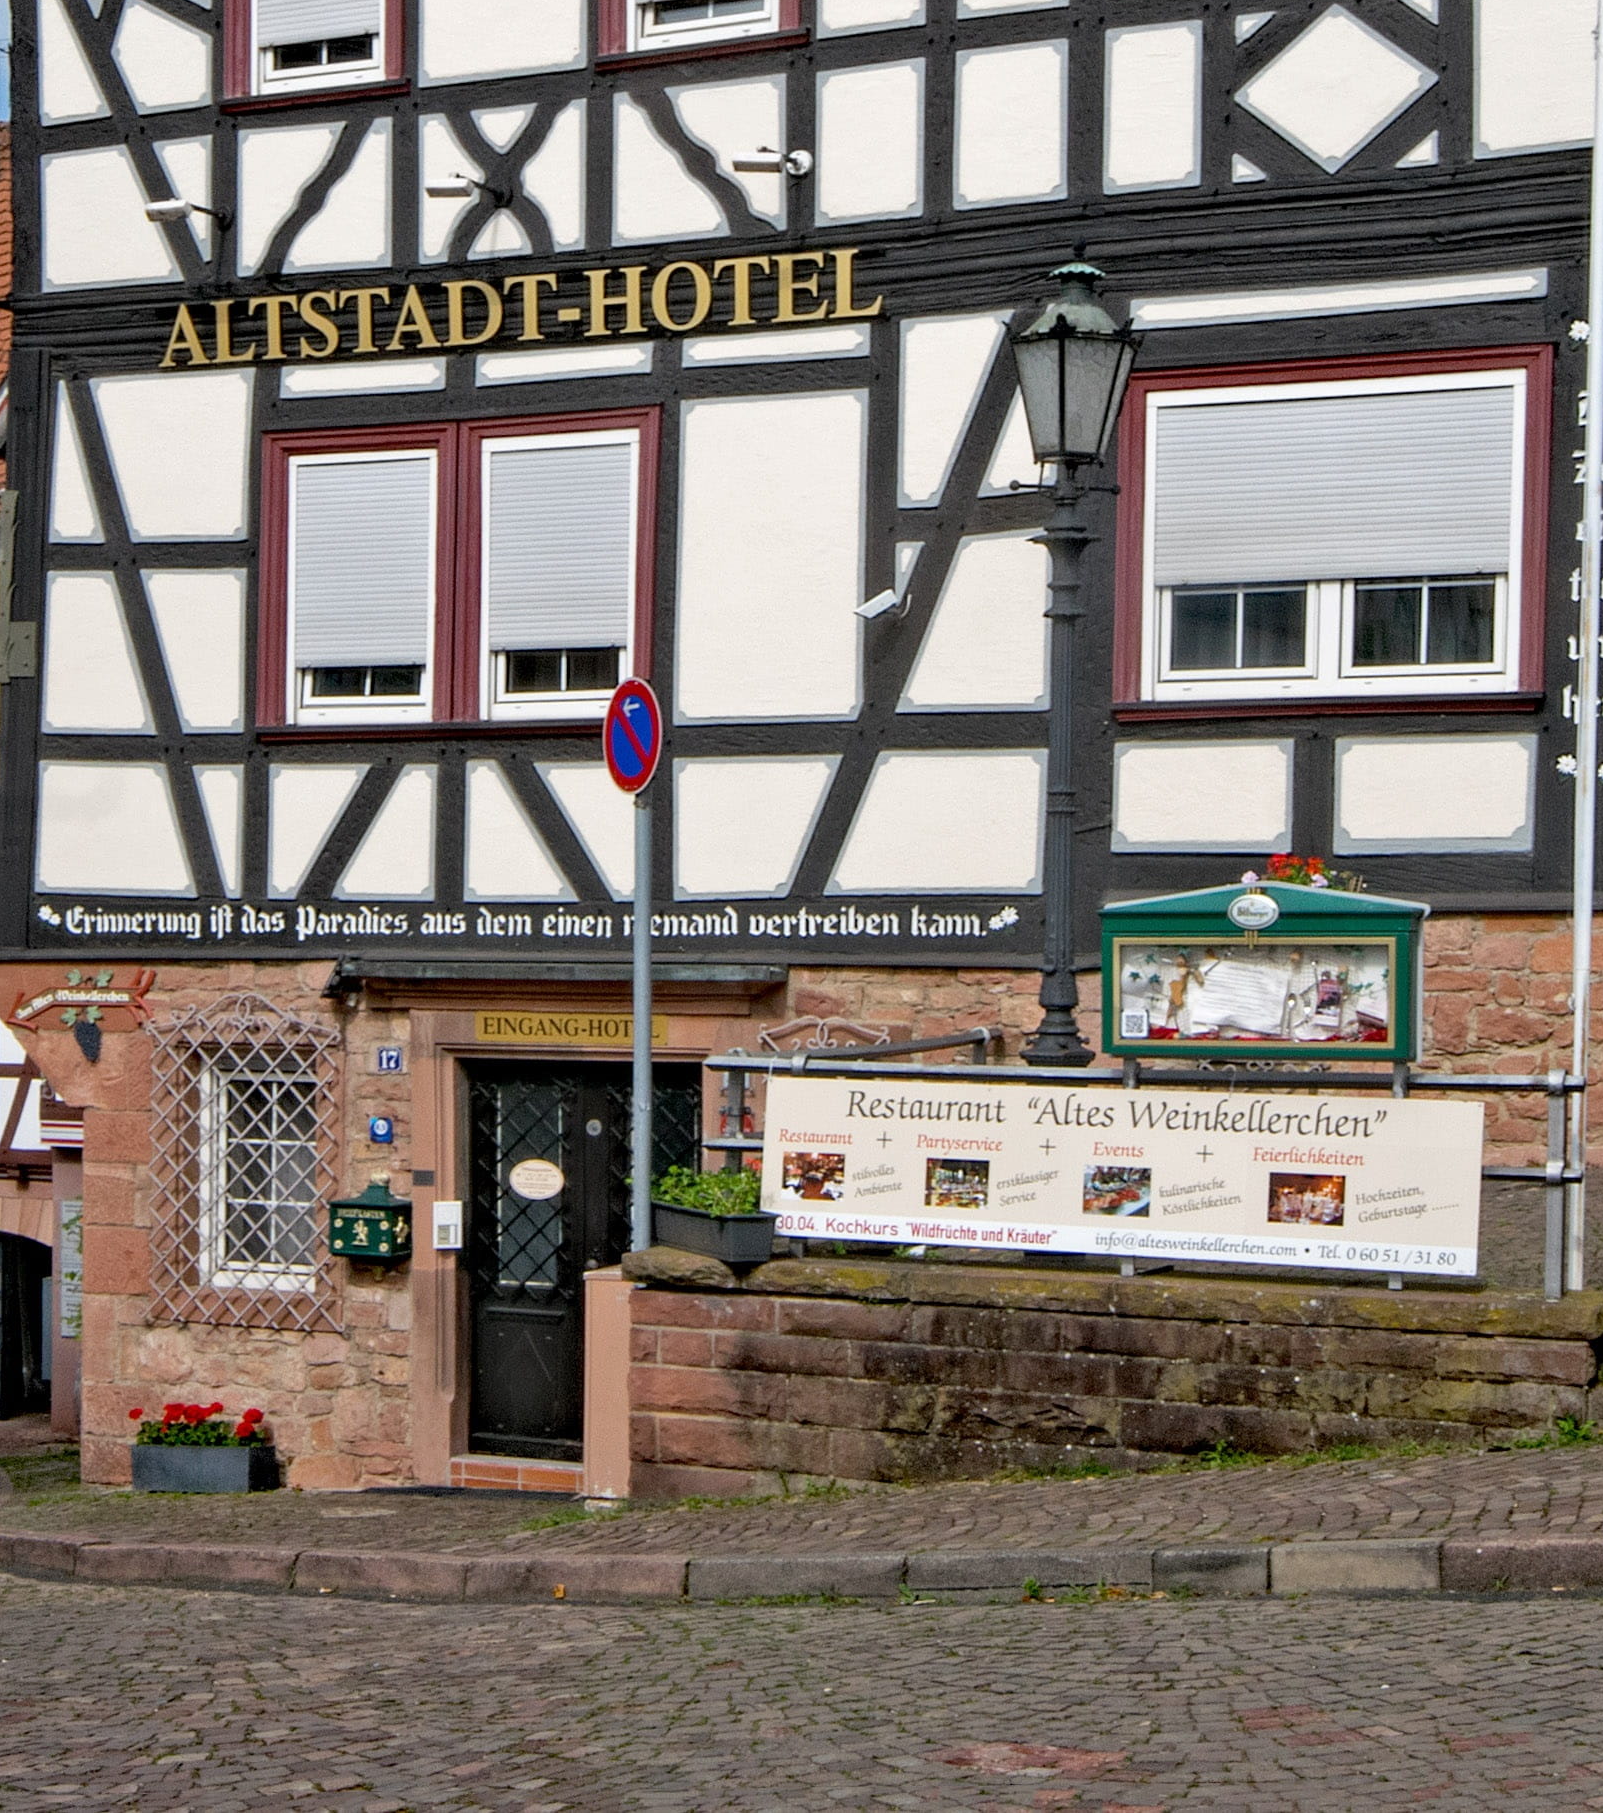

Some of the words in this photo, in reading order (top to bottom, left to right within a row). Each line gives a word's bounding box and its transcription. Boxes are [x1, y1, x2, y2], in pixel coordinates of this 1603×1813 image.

[158, 248, 883, 368] ALTSTADT-HOTEL
[65, 905, 201, 939] Erinnerung
[240, 905, 286, 935] das
[420, 911, 466, 936] aus
[476, 907, 533, 937] dem
[542, 906, 612, 938] einen
[622, 905, 739, 937] nemand
[748, 905, 900, 938] vertreiben
[910, 904, 988, 938] kann.
[483, 1016, 660, 1038] EINGANG-HOTL
[379, 1050, 399, 1070] 17
[846, 1089, 1007, 1124] Restaurant
[778, 1128, 853, 1146] Restaurant
[916, 1133, 1003, 1155] Partyservice
[1092, 1141, 1145, 1158] Events
[1252, 1146, 1365, 1166] Feierlichkeiten
[852, 1165, 895, 1182] stilvolles
[996, 1168, 1060, 1190] erstklassiger
[854, 1181, 903, 1198] Ambiente
[1158, 1176, 1226, 1198] kulinarische
[1355, 1186, 1425, 1206] Hochzeiten,
[998, 1191, 1038, 1207] Service
[1162, 1193, 1242, 1216] Köstlichkeiten
[1357, 1201, 1428, 1224] Geburtstage
[775, 1215, 819, 1232] 30.04.
[825, 1218, 899, 1237] Kochkurs
[981, 1227, 1003, 1242] und
[1095, 1231, 1298, 1257] info@altesweinkellerchen.com
[1317, 1244, 1340, 1260] Tel.
[1437, 1252, 1457, 1266] 80
